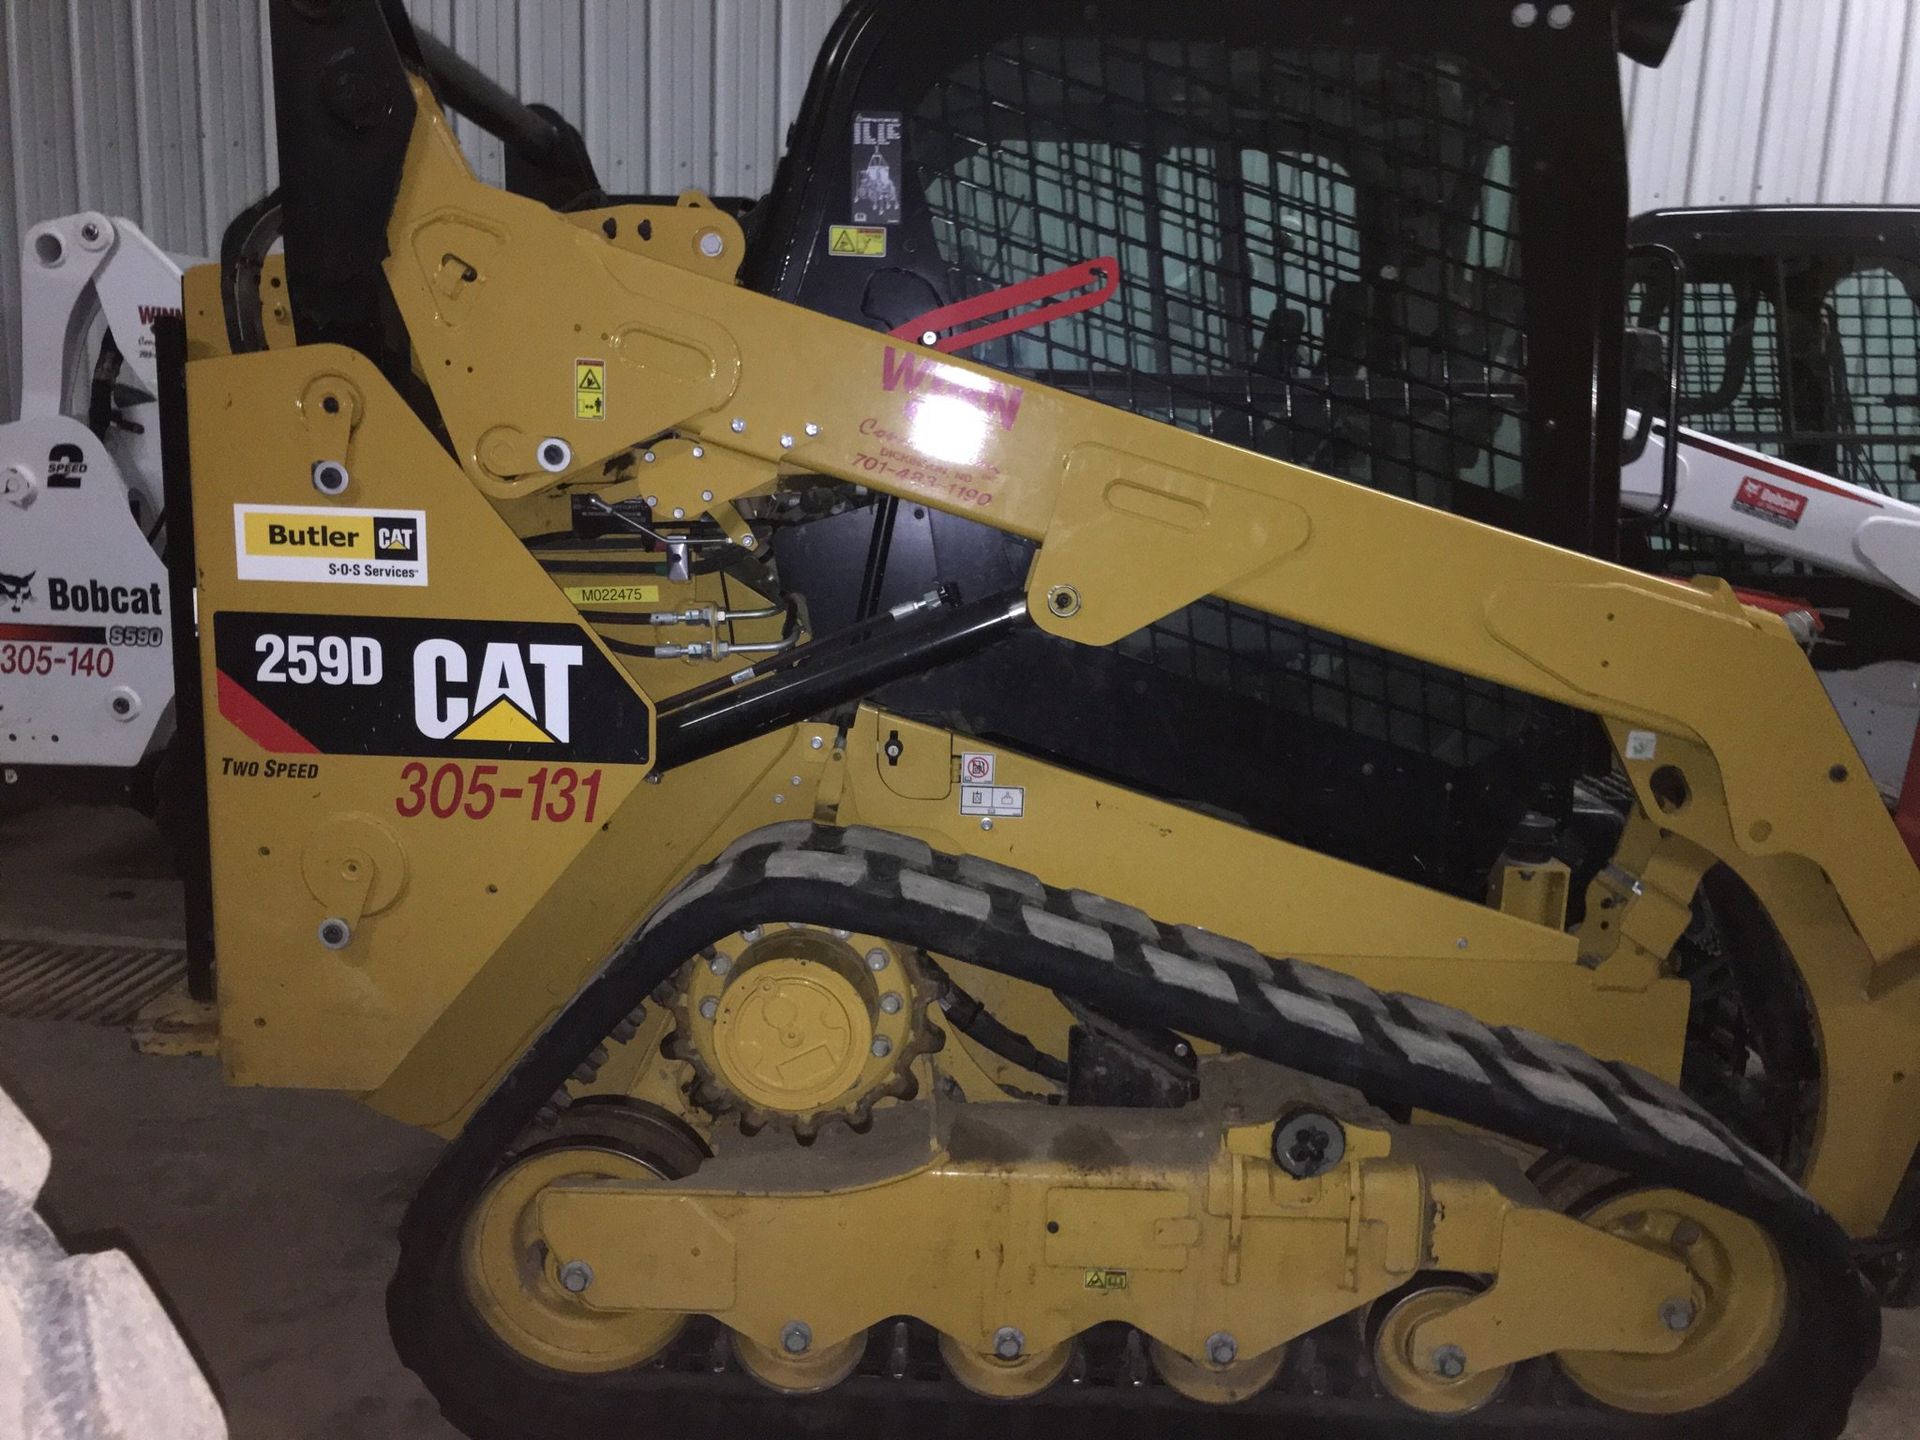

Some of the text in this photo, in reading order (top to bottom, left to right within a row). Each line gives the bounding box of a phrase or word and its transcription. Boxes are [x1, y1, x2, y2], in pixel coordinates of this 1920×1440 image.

[47, 443, 84, 488] 2
[268, 524, 414, 550] Butler CAT
[48, 577, 163, 615] Bobcat
[582, 588, 642, 602] M022475
[109, 625, 163, 648] S590
[1, 644, 114, 677] 305-140
[254, 633, 383, 685] 259D
[413, 638, 583, 744] CAT
[395, 761, 602, 823] 305-131
